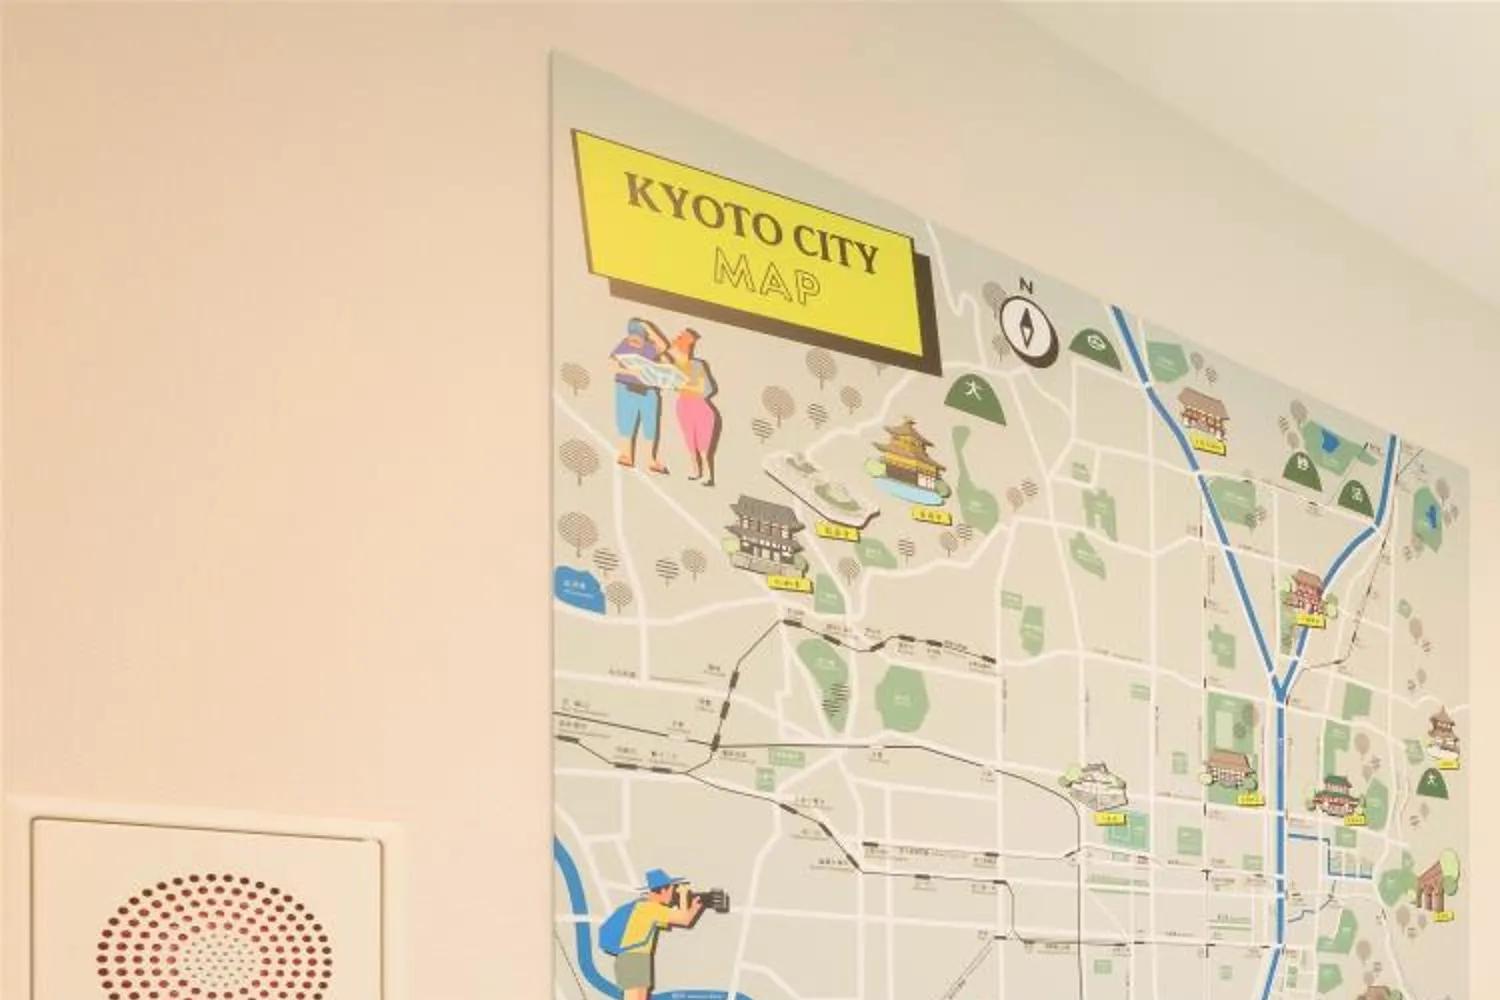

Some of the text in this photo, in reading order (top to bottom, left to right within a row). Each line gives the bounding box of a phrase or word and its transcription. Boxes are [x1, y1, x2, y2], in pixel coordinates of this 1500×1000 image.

[624, 172, 880, 275] KYOTO CITY
[712, 246, 822, 306] MAP
[1019, 277, 1034, 295] N
